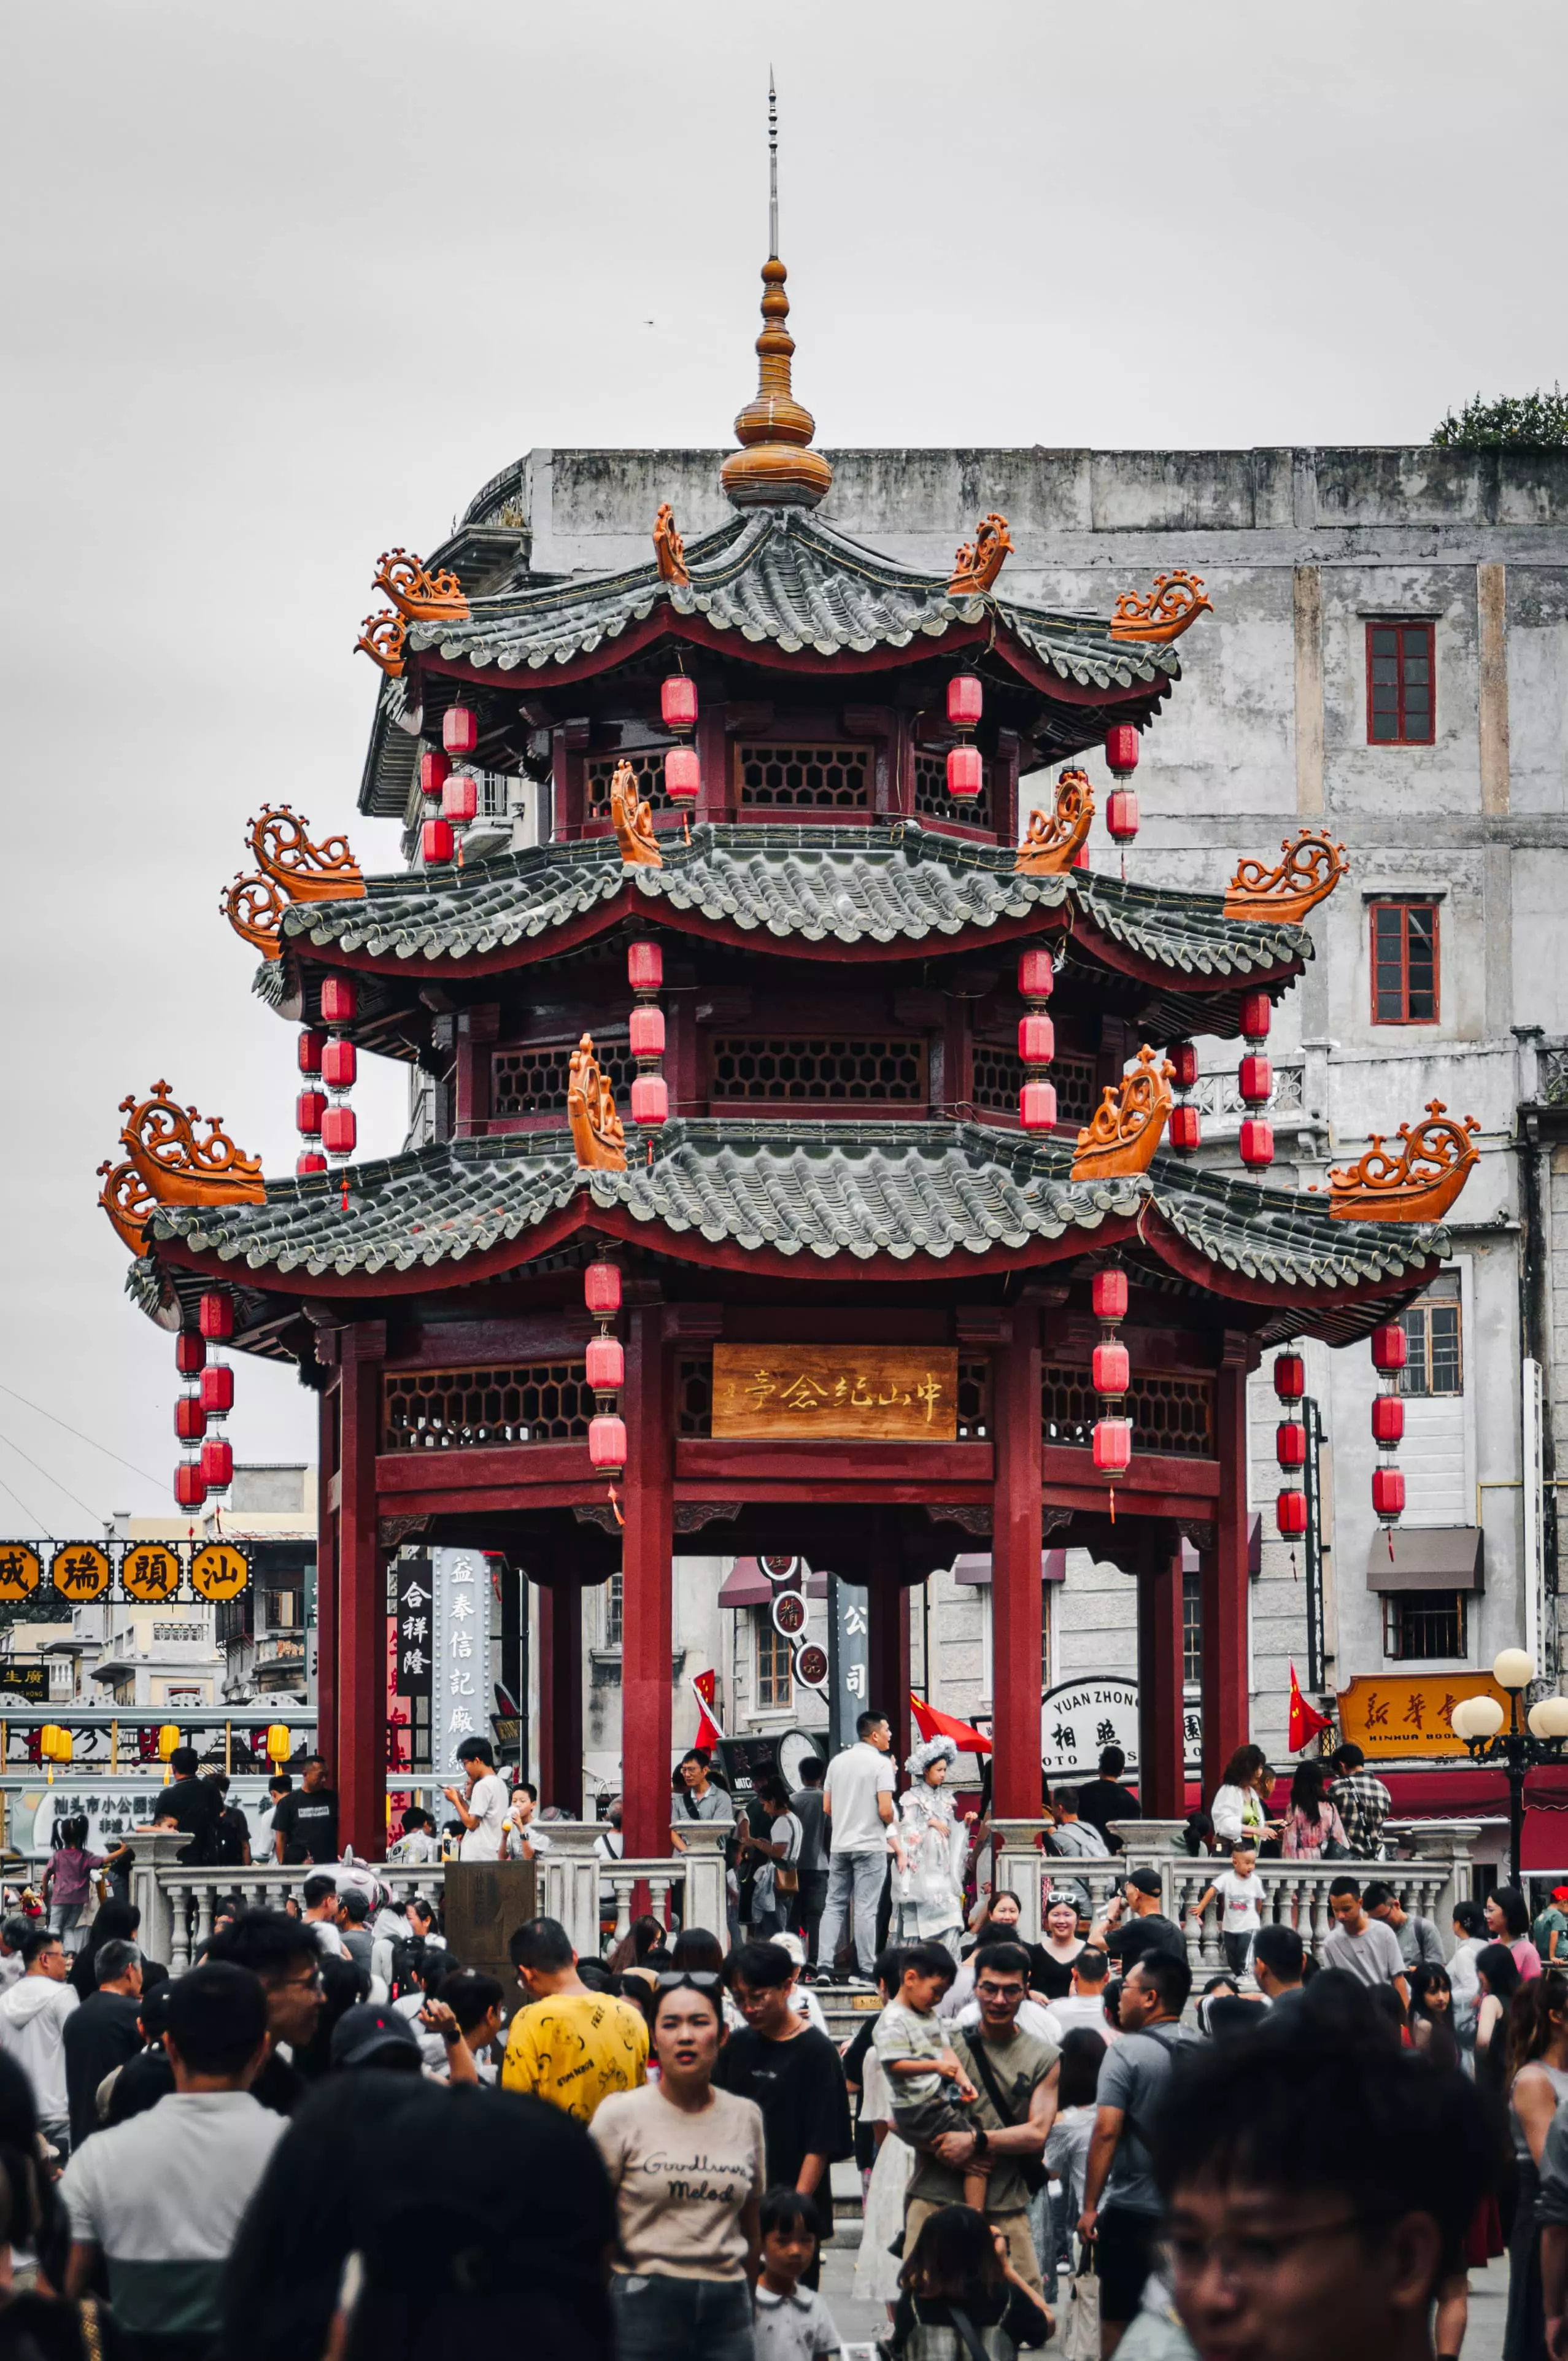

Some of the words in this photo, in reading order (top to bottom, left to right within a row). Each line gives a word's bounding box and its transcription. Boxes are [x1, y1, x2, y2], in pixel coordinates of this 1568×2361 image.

[400, 1581, 432, 1674] 合祥隆
[1054, 1692, 1091, 1714] YUAN
[1094, 1691, 1139, 1707] ZHON
[735, 1777, 752, 1789] WATC
